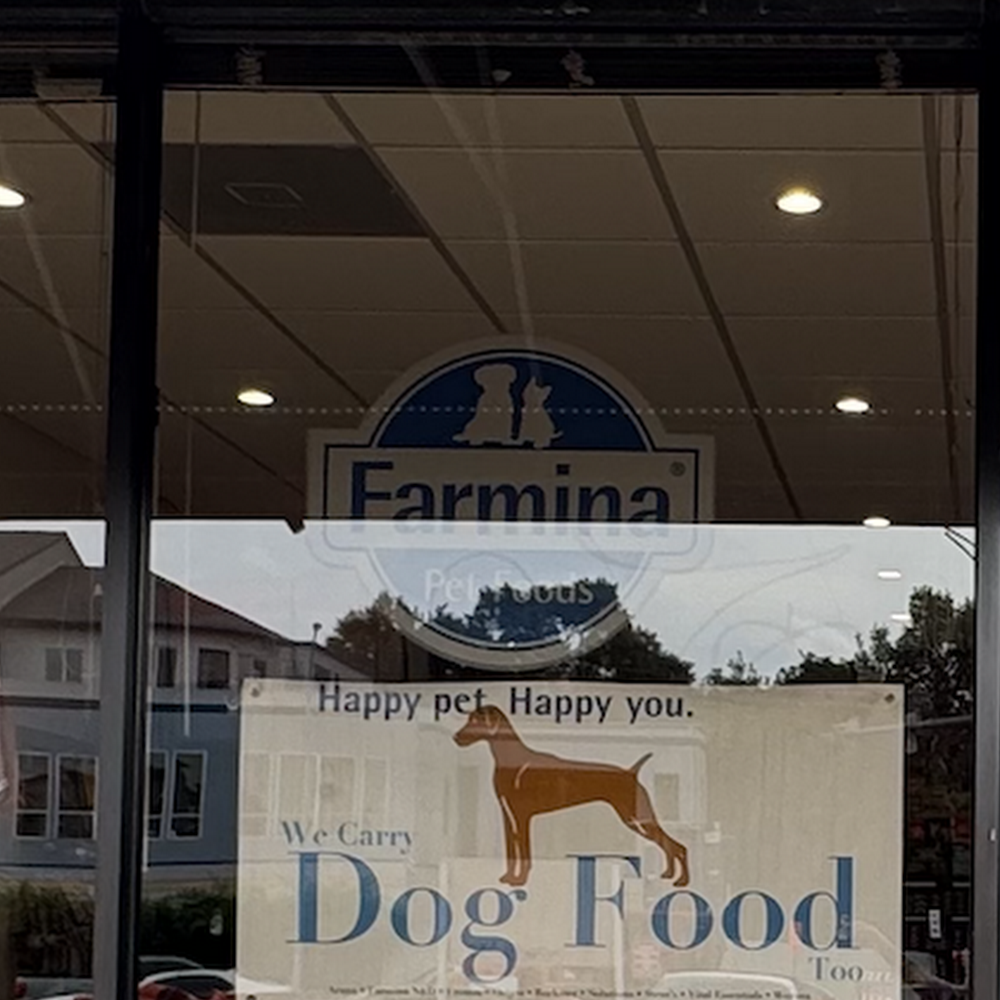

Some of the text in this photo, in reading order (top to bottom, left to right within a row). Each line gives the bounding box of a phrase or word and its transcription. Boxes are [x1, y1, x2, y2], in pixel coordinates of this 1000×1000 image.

[350, 460, 670, 538] Farmina
[425, 568, 595, 605] Pet Foods
[317, 684, 421, 722] Happy
[509, 686, 611, 724] Happy
[626, 694, 693, 725] you.
[281, 820, 413, 855] We Carry
[285, 850, 859, 984] Dog Food
[808, 956, 863, 982] Too
